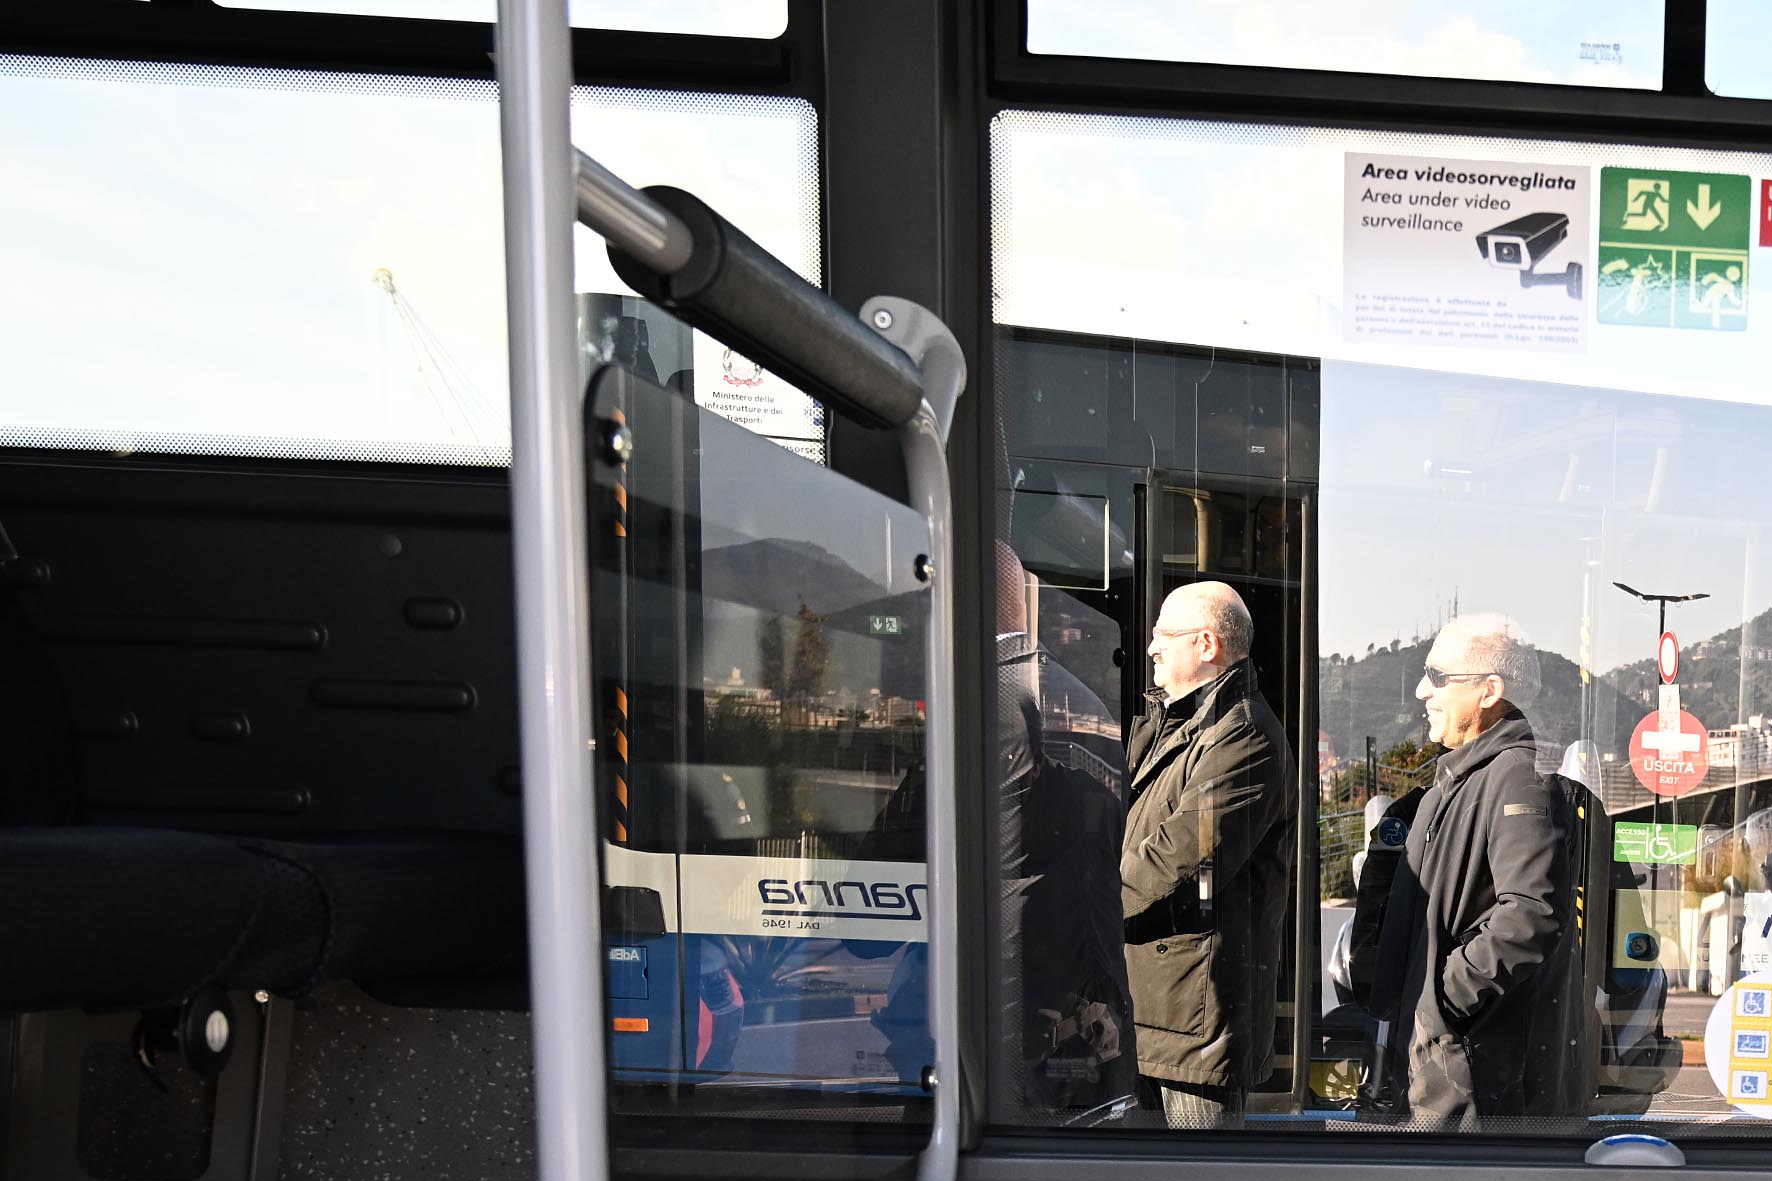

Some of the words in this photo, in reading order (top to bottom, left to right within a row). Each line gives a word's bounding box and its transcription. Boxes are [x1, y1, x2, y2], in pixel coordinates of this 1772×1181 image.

[1361, 163, 1408, 180] Area
[1415, 166, 1576, 192] videosorvegliata
[1361, 188, 1402, 205] Area
[1409, 191, 1459, 208] under
[1465, 194, 1511, 211] video
[1361, 213, 1463, 233] surveillance
[712, 391, 753, 402] Ministero
[704, 402, 761, 413] Infrastrutture
[1643, 759, 1695, 774] USCITA
[1659, 775, 1680, 785] EXIT
